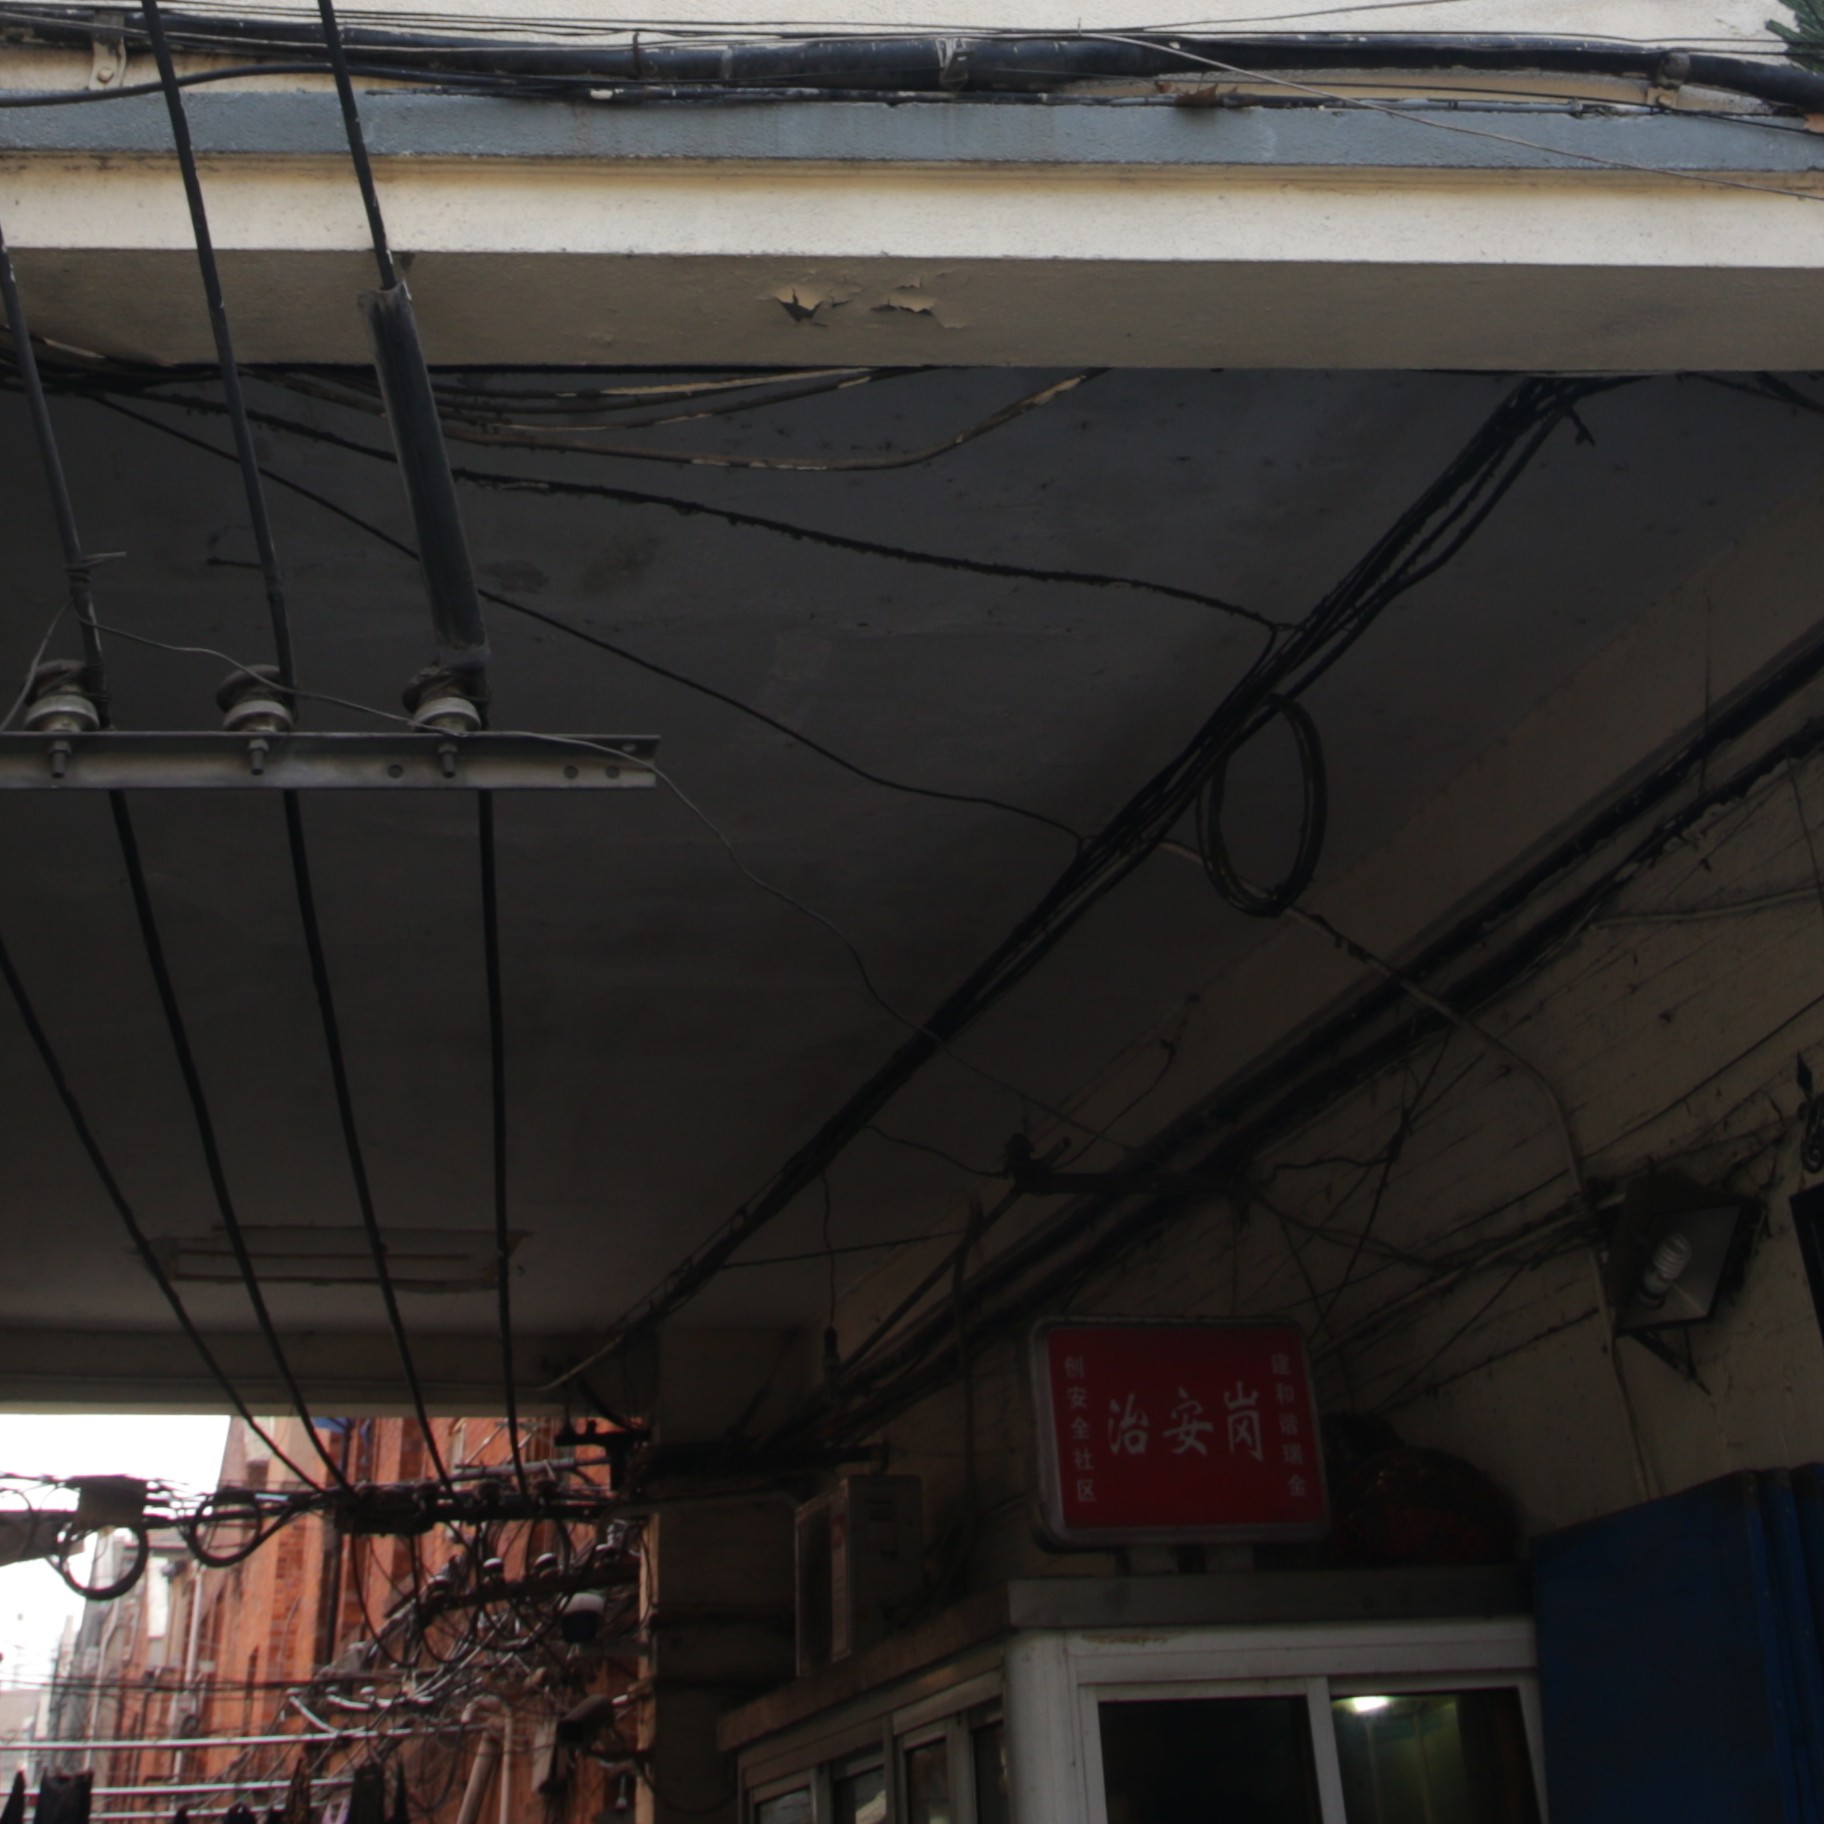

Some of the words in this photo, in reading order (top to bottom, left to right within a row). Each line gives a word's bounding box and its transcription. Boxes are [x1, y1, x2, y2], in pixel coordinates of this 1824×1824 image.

[1063, 1356, 1097, 1503] 创安全社区
[1107, 1379, 1265, 1463] 治安岗
[1270, 1352, 1307, 1498] 建和谐瑞金
